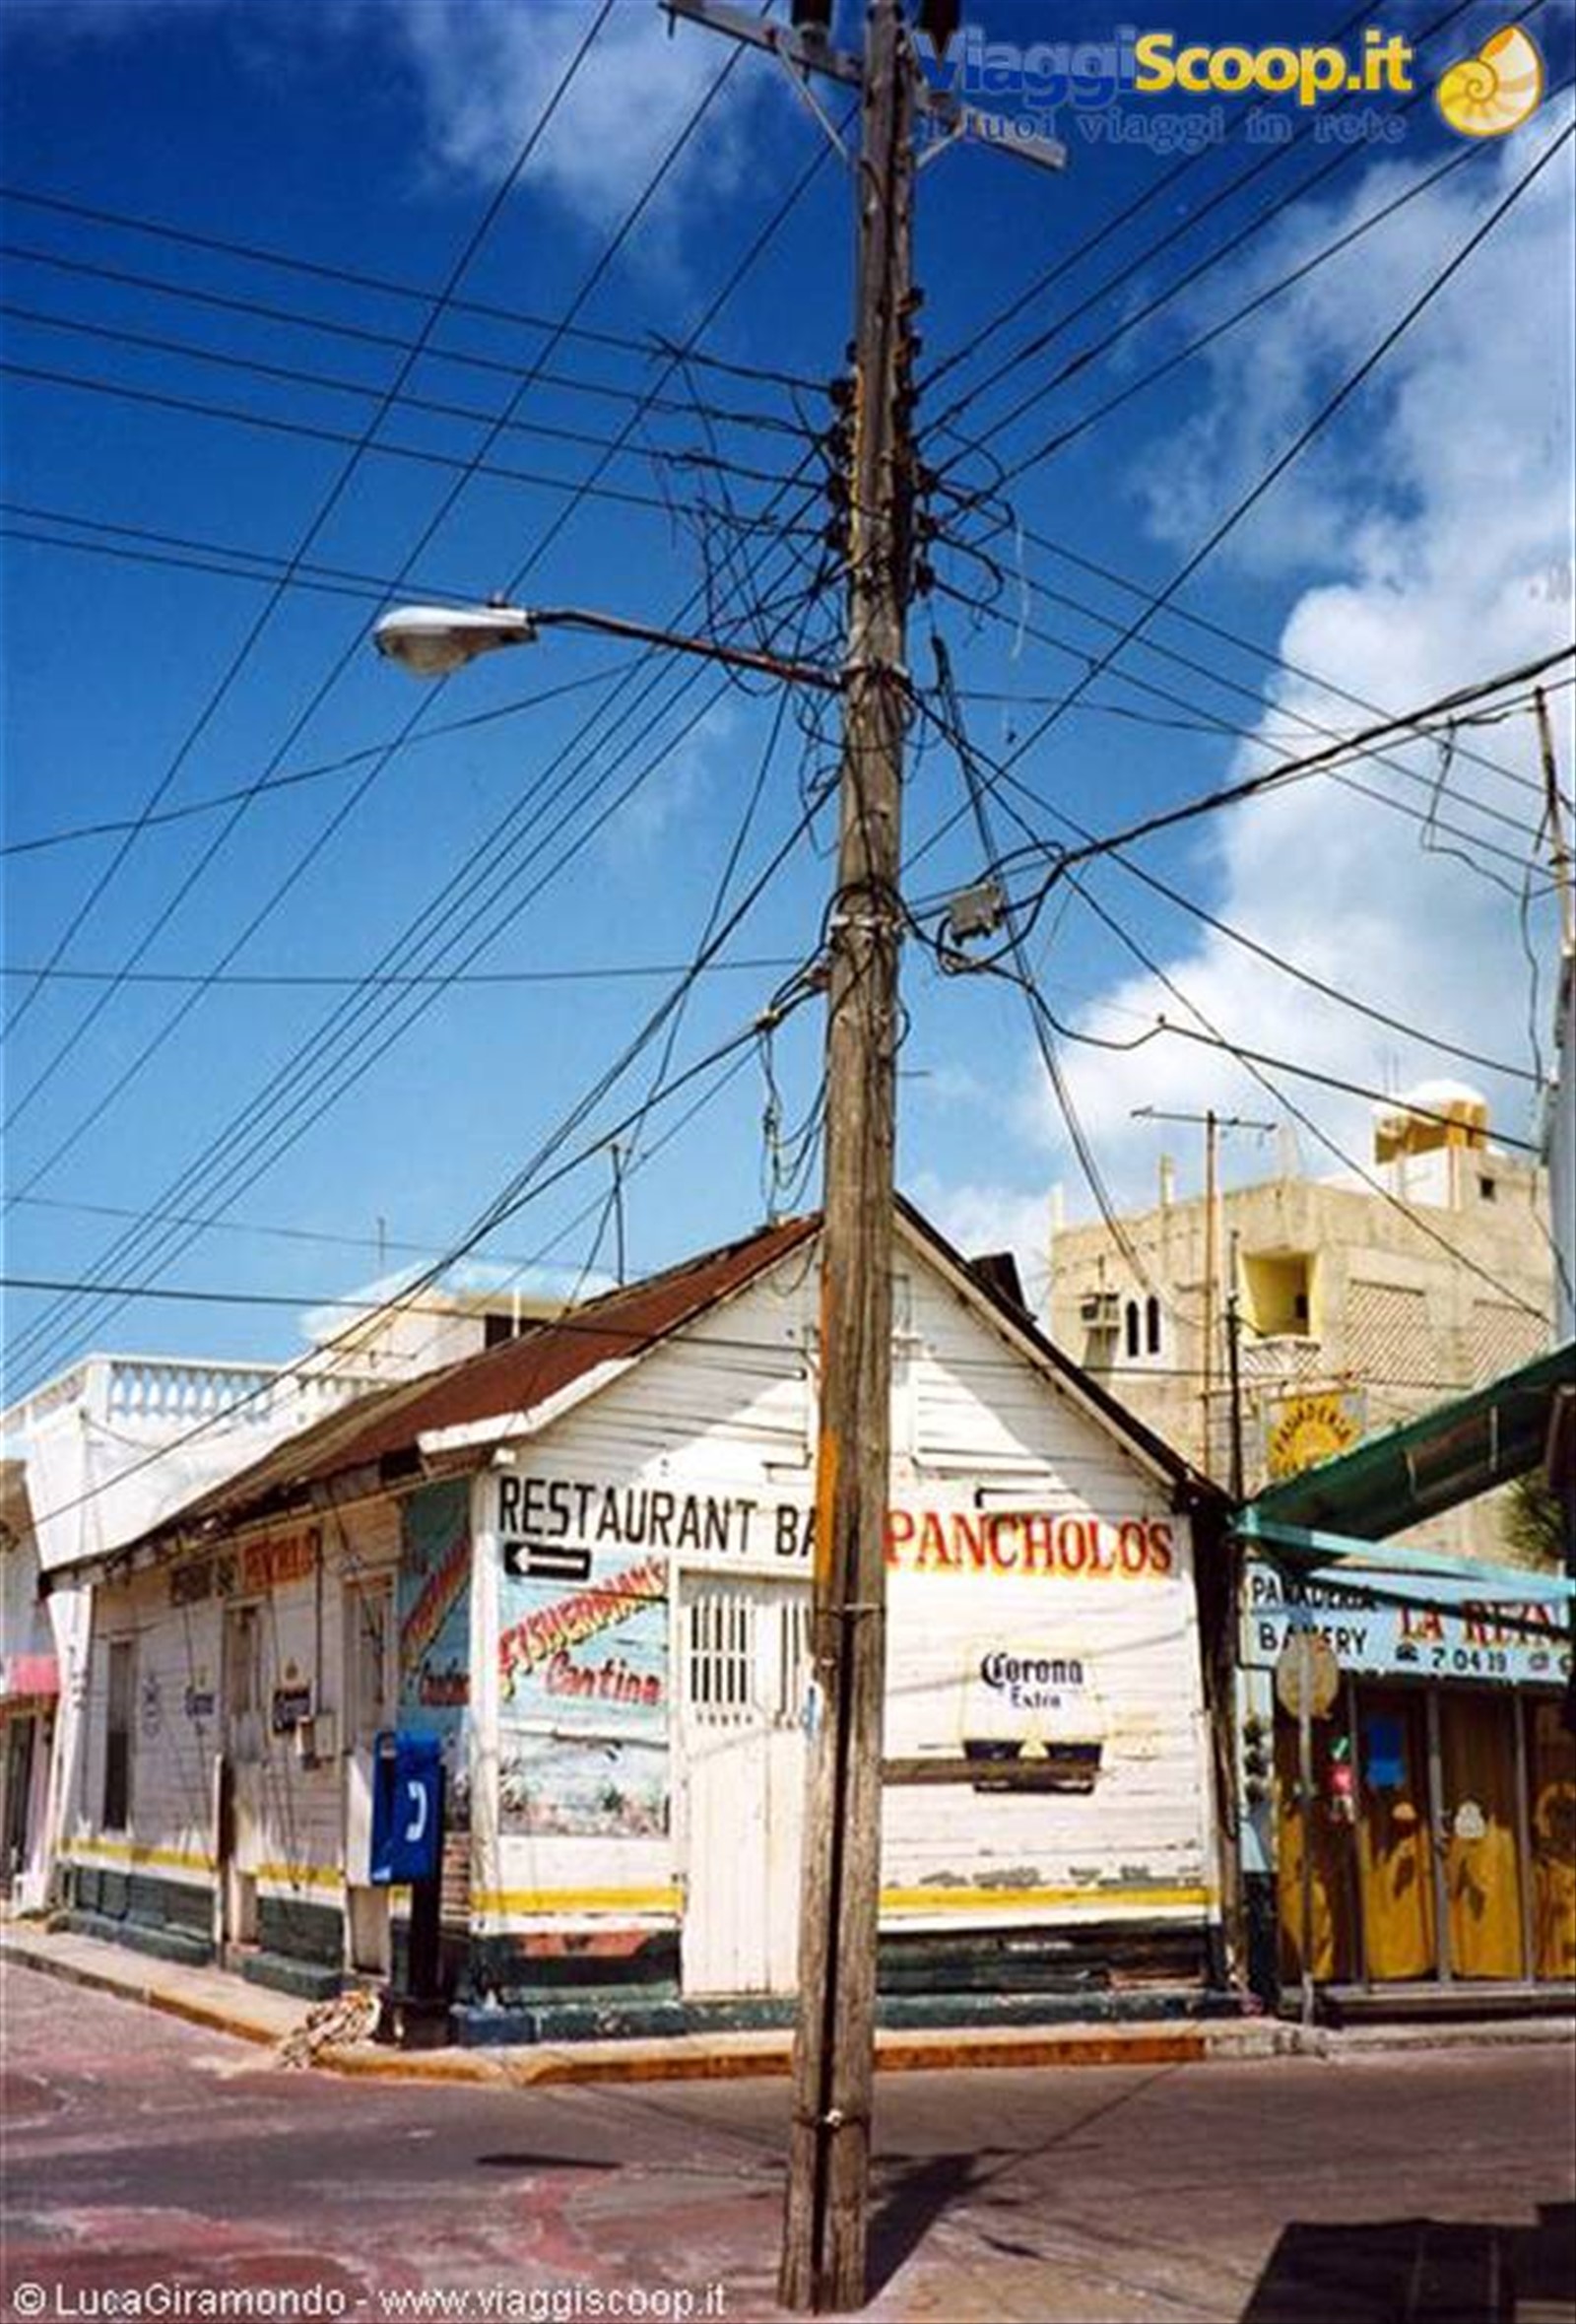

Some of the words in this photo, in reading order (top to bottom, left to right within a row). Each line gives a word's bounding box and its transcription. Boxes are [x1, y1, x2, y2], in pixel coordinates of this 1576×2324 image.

[498, 1478, 757, 1553] RESTAURANT
[775, 1504, 818, 1559] BA
[547, 1649, 661, 1706] Cantina
[980, 1652, 1084, 1689] Corona
[1010, 1686, 1062, 1709] Extra
